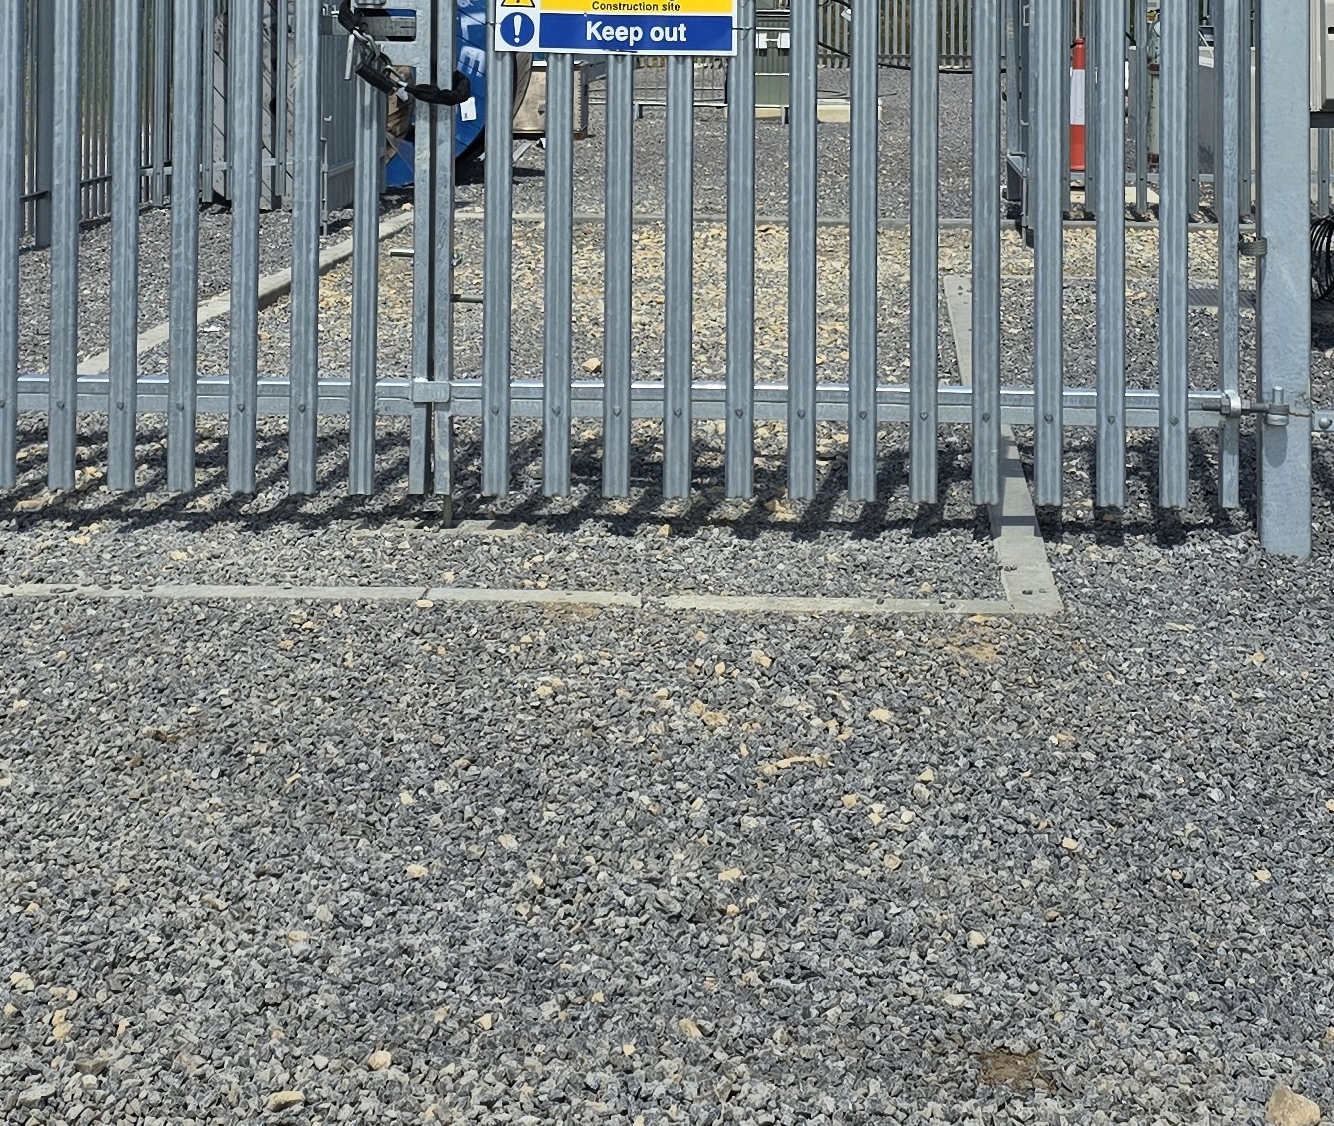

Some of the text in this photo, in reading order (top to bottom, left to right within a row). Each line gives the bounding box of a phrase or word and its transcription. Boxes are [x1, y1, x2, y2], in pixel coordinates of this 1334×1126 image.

[591, 1, 681, 12] Construction site
[586, 20, 687, 47] Keep out
